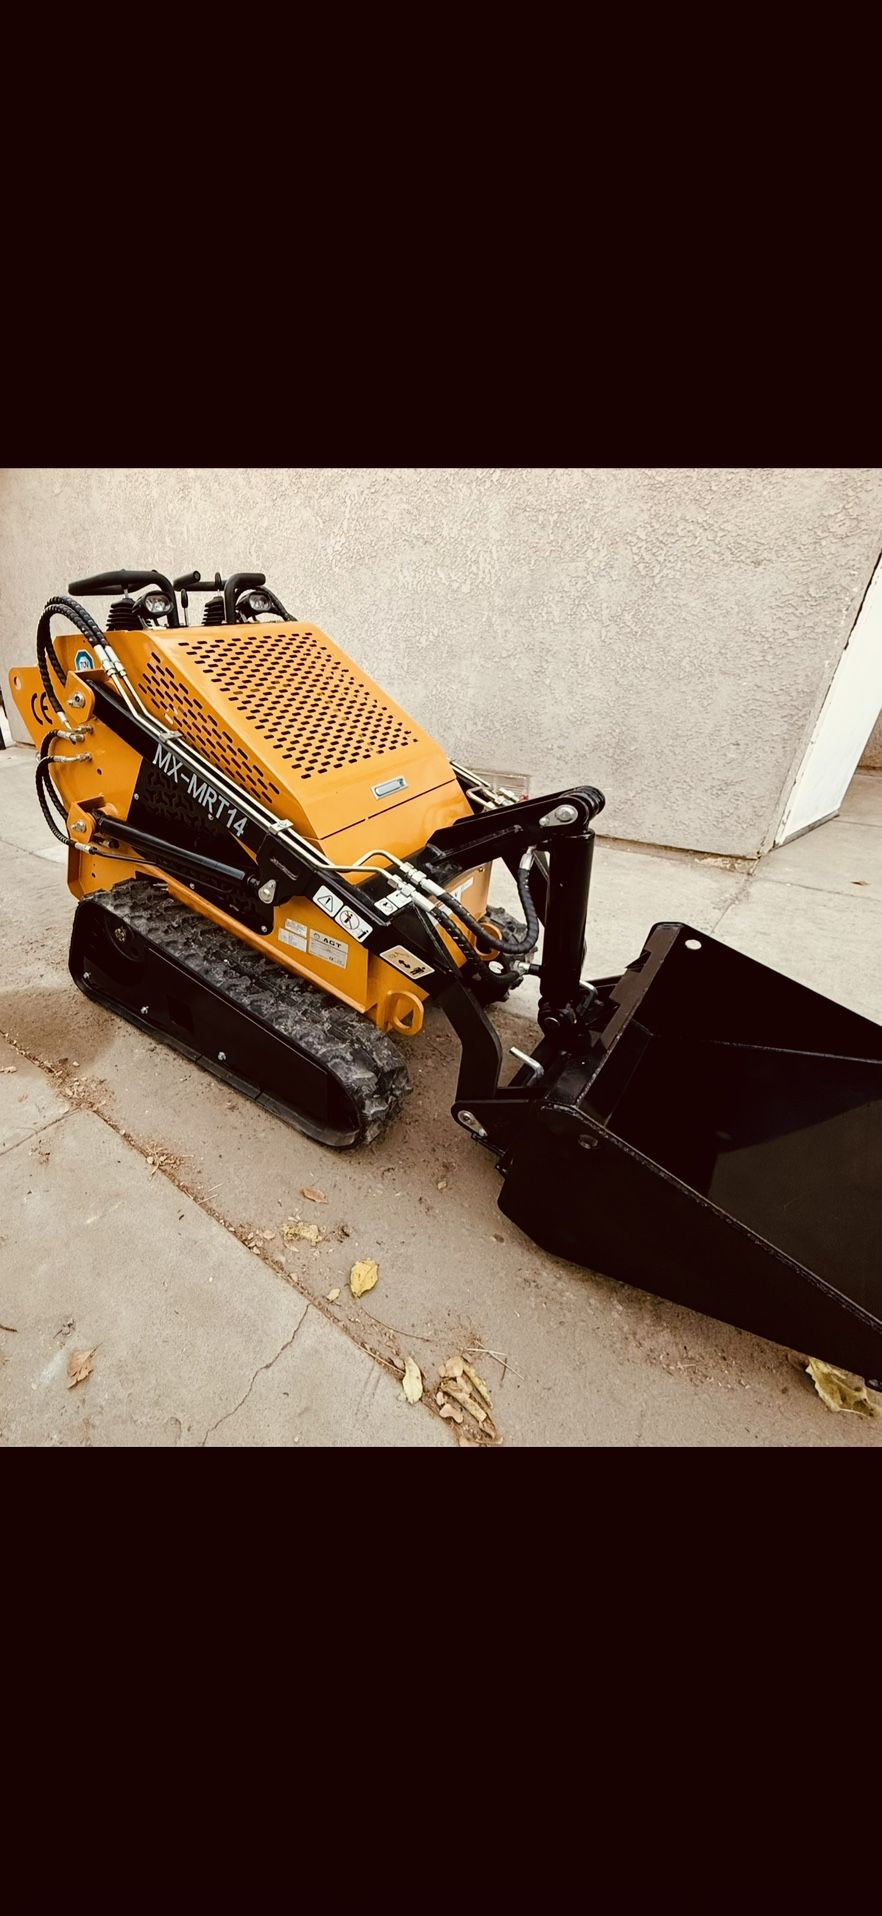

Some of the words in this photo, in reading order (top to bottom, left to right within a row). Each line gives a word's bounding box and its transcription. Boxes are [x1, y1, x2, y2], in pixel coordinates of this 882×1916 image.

[31, 691, 53, 726] CE
[152, 743, 248, 837] MX-MRT14
[323, 937, 342, 948] AGT
